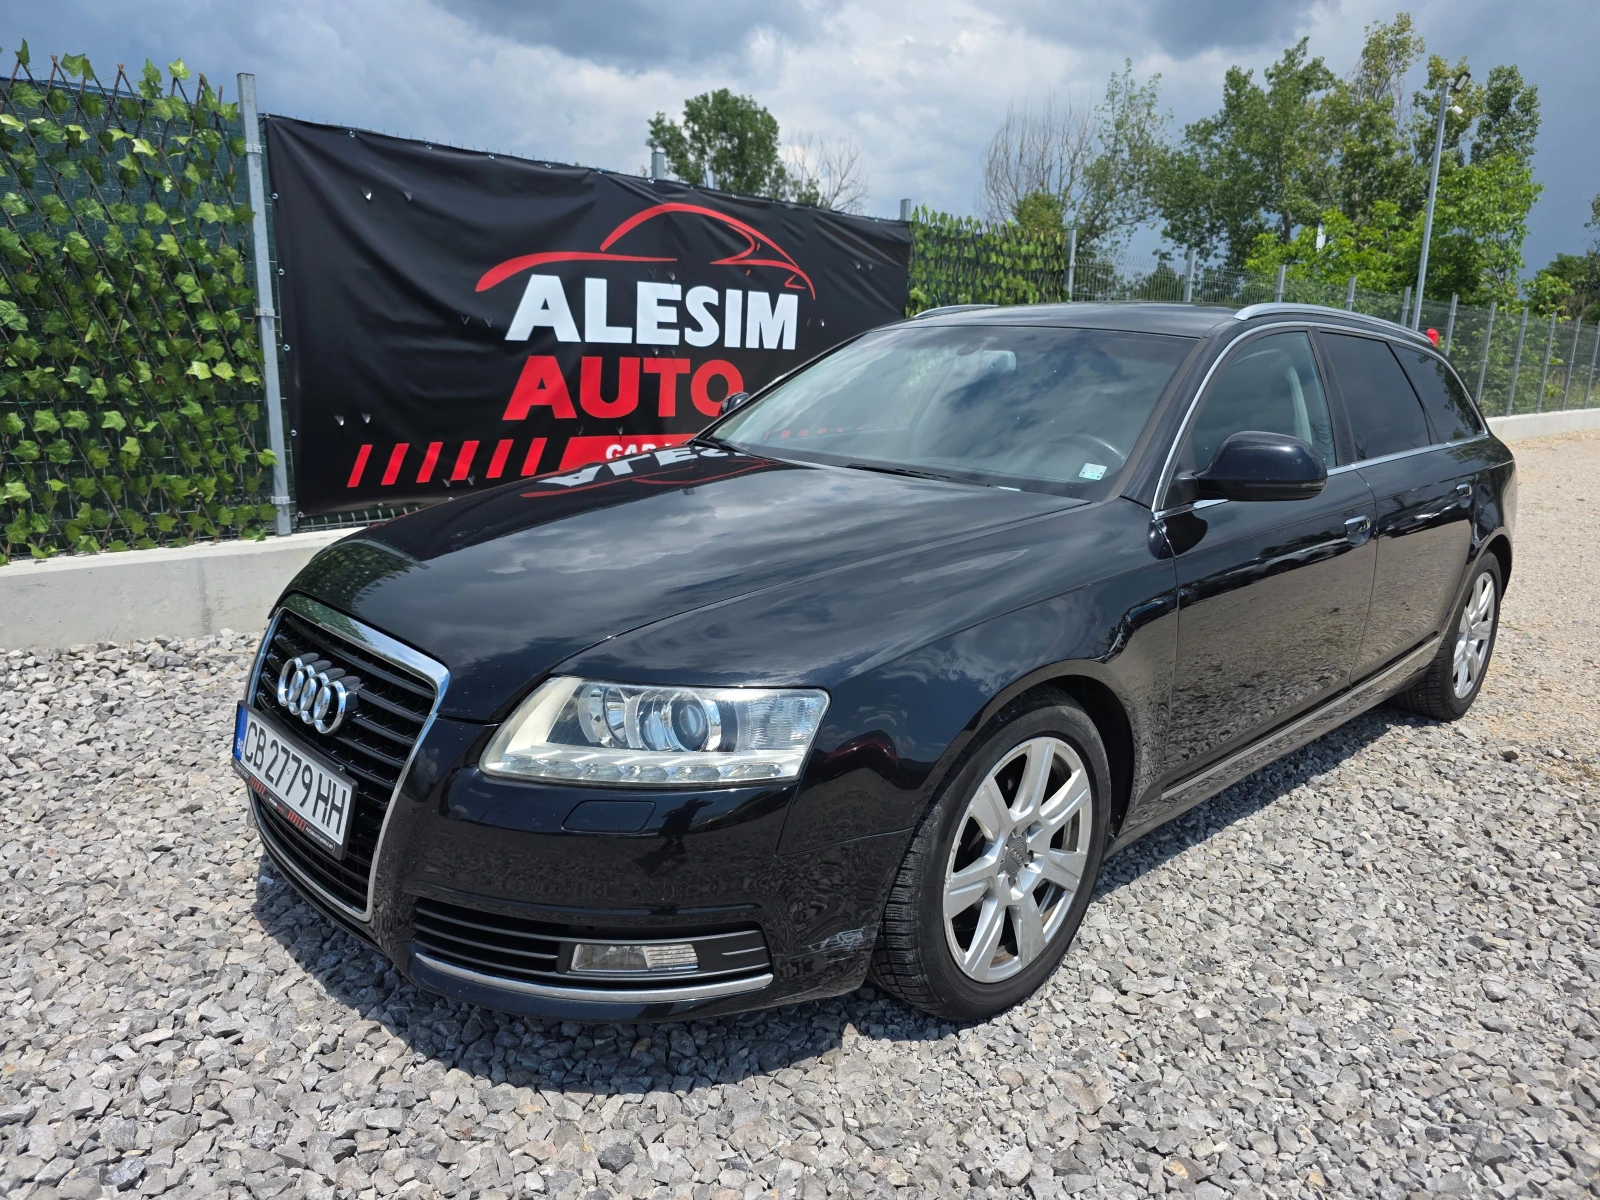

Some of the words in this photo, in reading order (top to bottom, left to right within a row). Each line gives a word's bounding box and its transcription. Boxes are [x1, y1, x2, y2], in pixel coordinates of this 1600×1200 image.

[504, 274, 799, 351] ALESIM
[502, 355, 745, 422] AUTO
[244, 720, 267, 772] CB
[264, 739, 314, 808] 2779
[312, 772, 347, 836] HH
